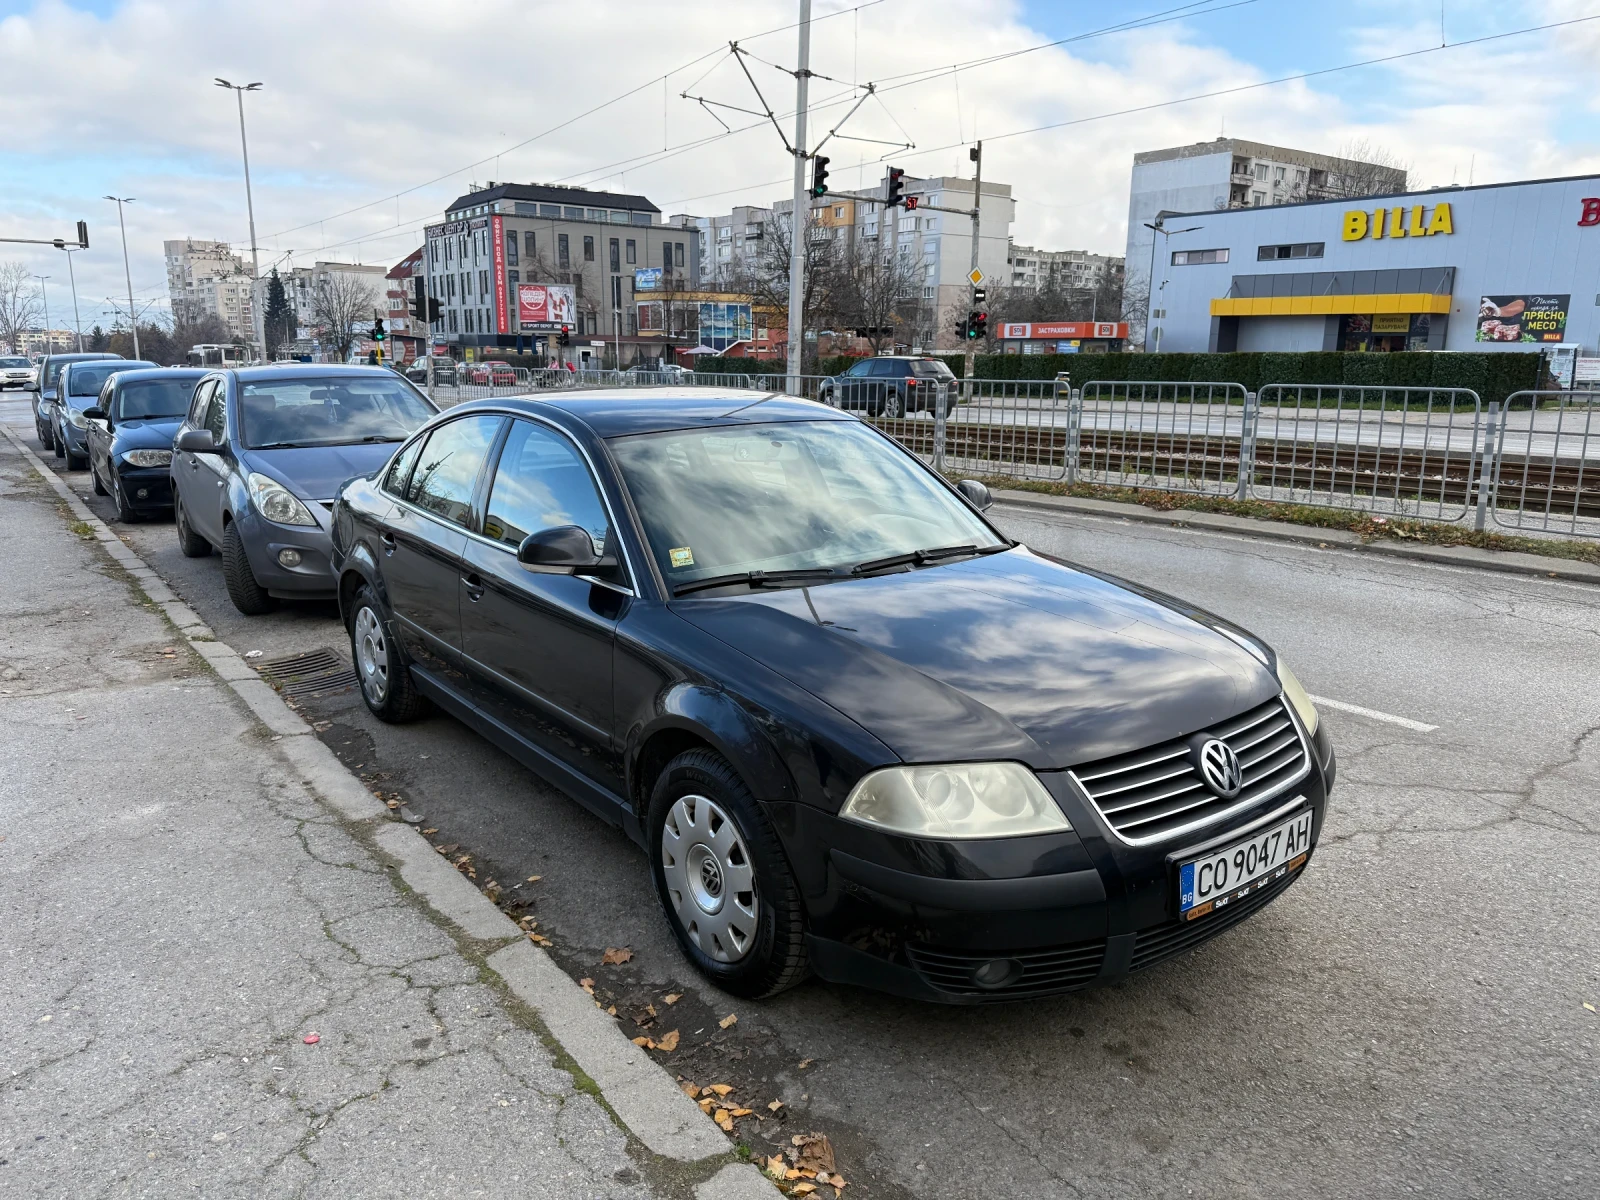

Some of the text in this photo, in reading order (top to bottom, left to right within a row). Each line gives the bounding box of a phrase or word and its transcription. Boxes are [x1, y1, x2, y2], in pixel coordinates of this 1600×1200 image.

[1342, 202, 1454, 242] BILLA
[428, 224, 445, 238] БИЗНЕС
[444, 222, 464, 235] ЦЕНТЪР
[1523, 311, 1565, 320] ПРЯСНО
[1528, 321, 1557, 330] МЕСО
[1233, 829, 1283, 884] 9047
[1284, 815, 1310, 859] AH
[1182, 892, 1193, 905] BG
